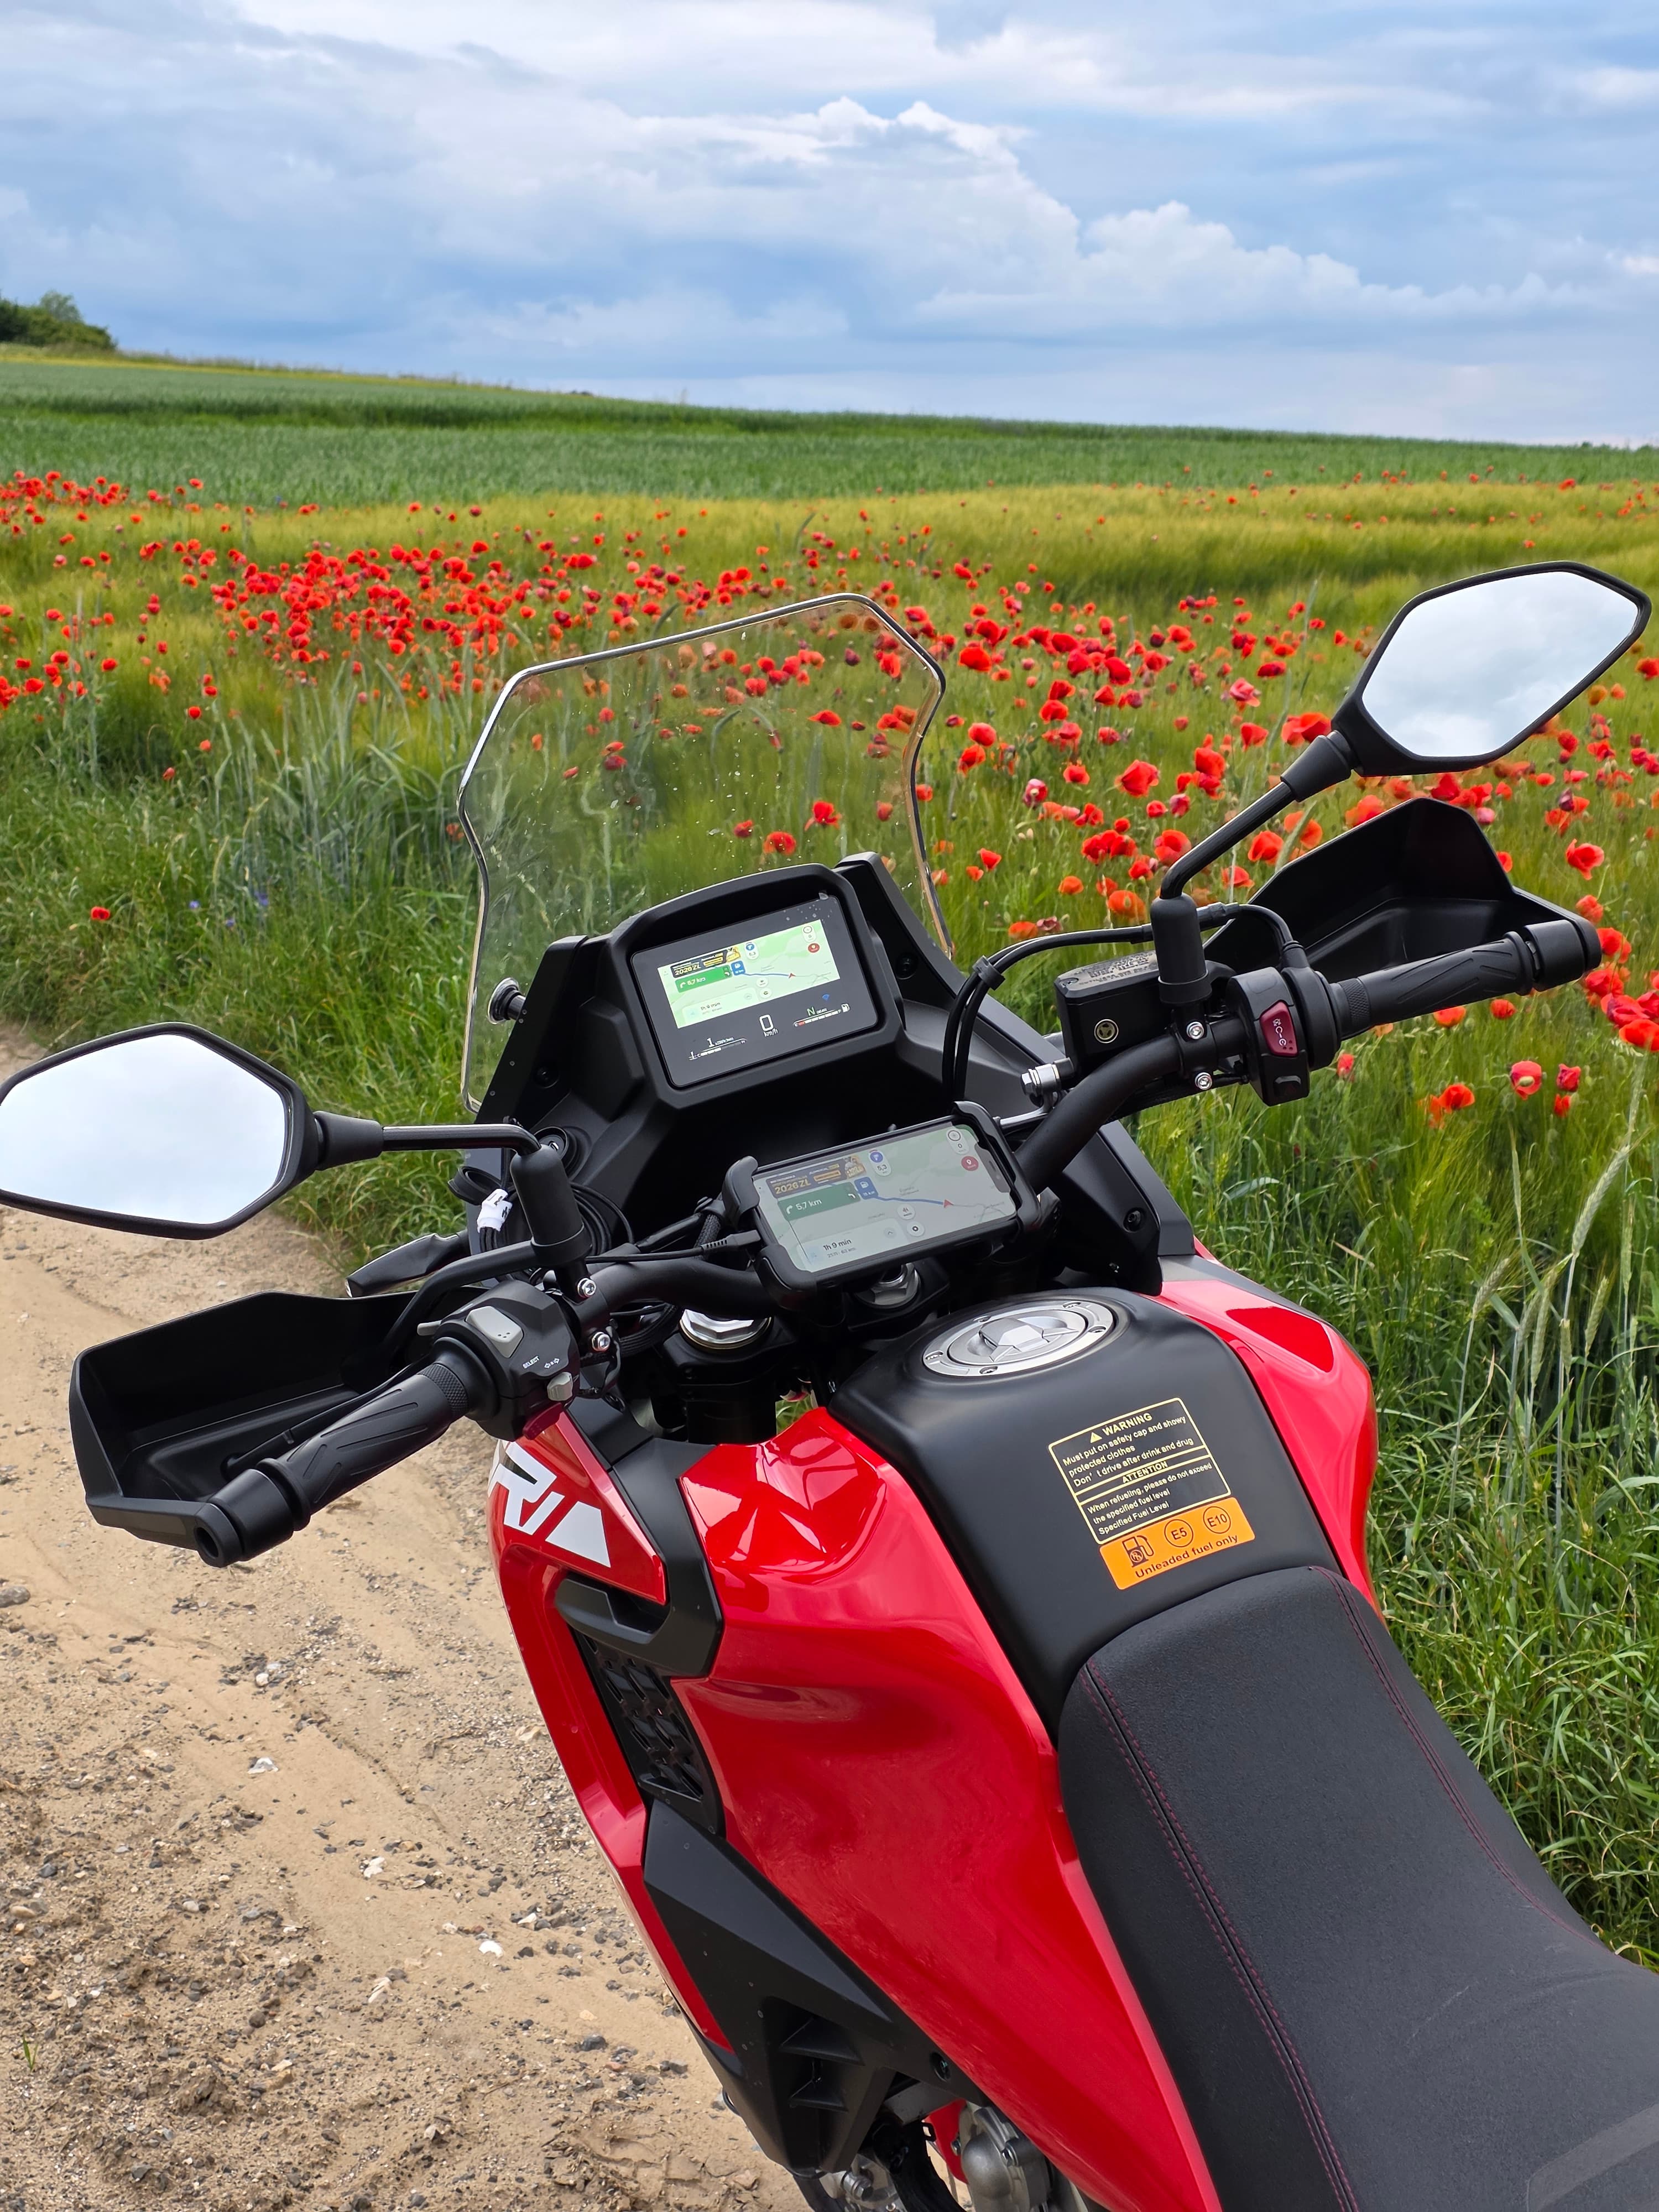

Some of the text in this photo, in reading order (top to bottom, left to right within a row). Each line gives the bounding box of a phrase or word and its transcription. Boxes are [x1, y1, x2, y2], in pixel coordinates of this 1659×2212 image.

[807, 1006, 816, 1016] N
[759, 1014, 774, 1031] 0
[763, 1029, 779, 1037] km/h
[796, 1198, 822, 1211] 5,7 km
[838, 1238, 852, 1248] min
[523, 1356, 540, 1368] SELECT
[1103, 1413, 1152, 1436] WARNING
[1062, 1453, 1084, 1467] Must
[1084, 1447, 1098, 1458] put
[1108, 1433, 1133, 1447] safety
[1134, 1429, 1147, 1438] cap
[1148, 1423, 1162, 1433] and
[1162, 1416, 1186, 1428] showy
[1069, 1445, 1135, 1478] protected clothes
[1102, 1464, 1121, 1475] drive
[1123, 1455, 1140, 1467] after
[1141, 1448, 1161, 1459] drink
[1162, 1442, 1176, 1452] and
[1176, 1438, 1194, 1447] drug
[1123, 1462, 1168, 1483] ATTENTION
[1088, 1501, 1109, 1514] When
[1109, 1486, 1144, 1505] refueling,
[1144, 1479, 1167, 1492] please
[1177, 1470, 1188, 1479] not
[1188, 1463, 1212, 1475] exceed
[1093, 1488, 1170, 1524] the specified fuel level
[1098, 1501, 1170, 1535] Specified Fuel Level
[1207, 1513, 1228, 1528] E10
[1171, 1527, 1187, 1540] E5
[1135, 1535, 1238, 1578] Unleaded fuel only
